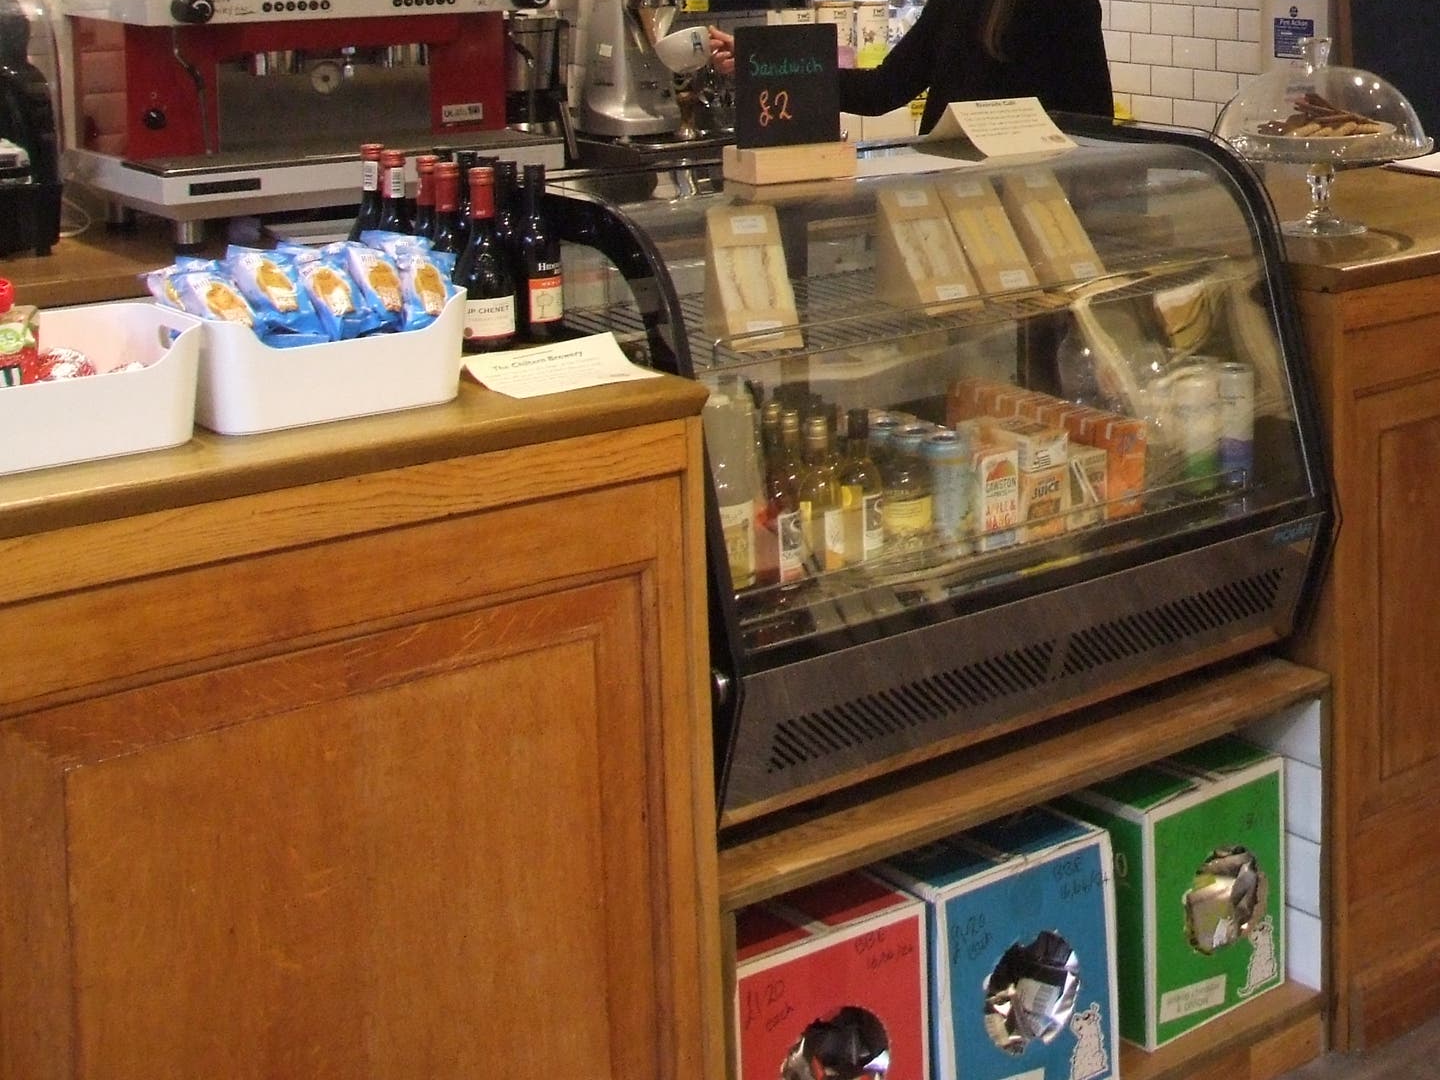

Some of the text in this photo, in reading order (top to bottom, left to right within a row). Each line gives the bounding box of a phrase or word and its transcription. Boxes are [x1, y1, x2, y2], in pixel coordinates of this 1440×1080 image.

[750, 54, 823, 77] Sandwich
[760, 90, 792, 127] £2
[479, 305, 509, 314] CHENET
[1032, 481, 1059, 499] JUICE
